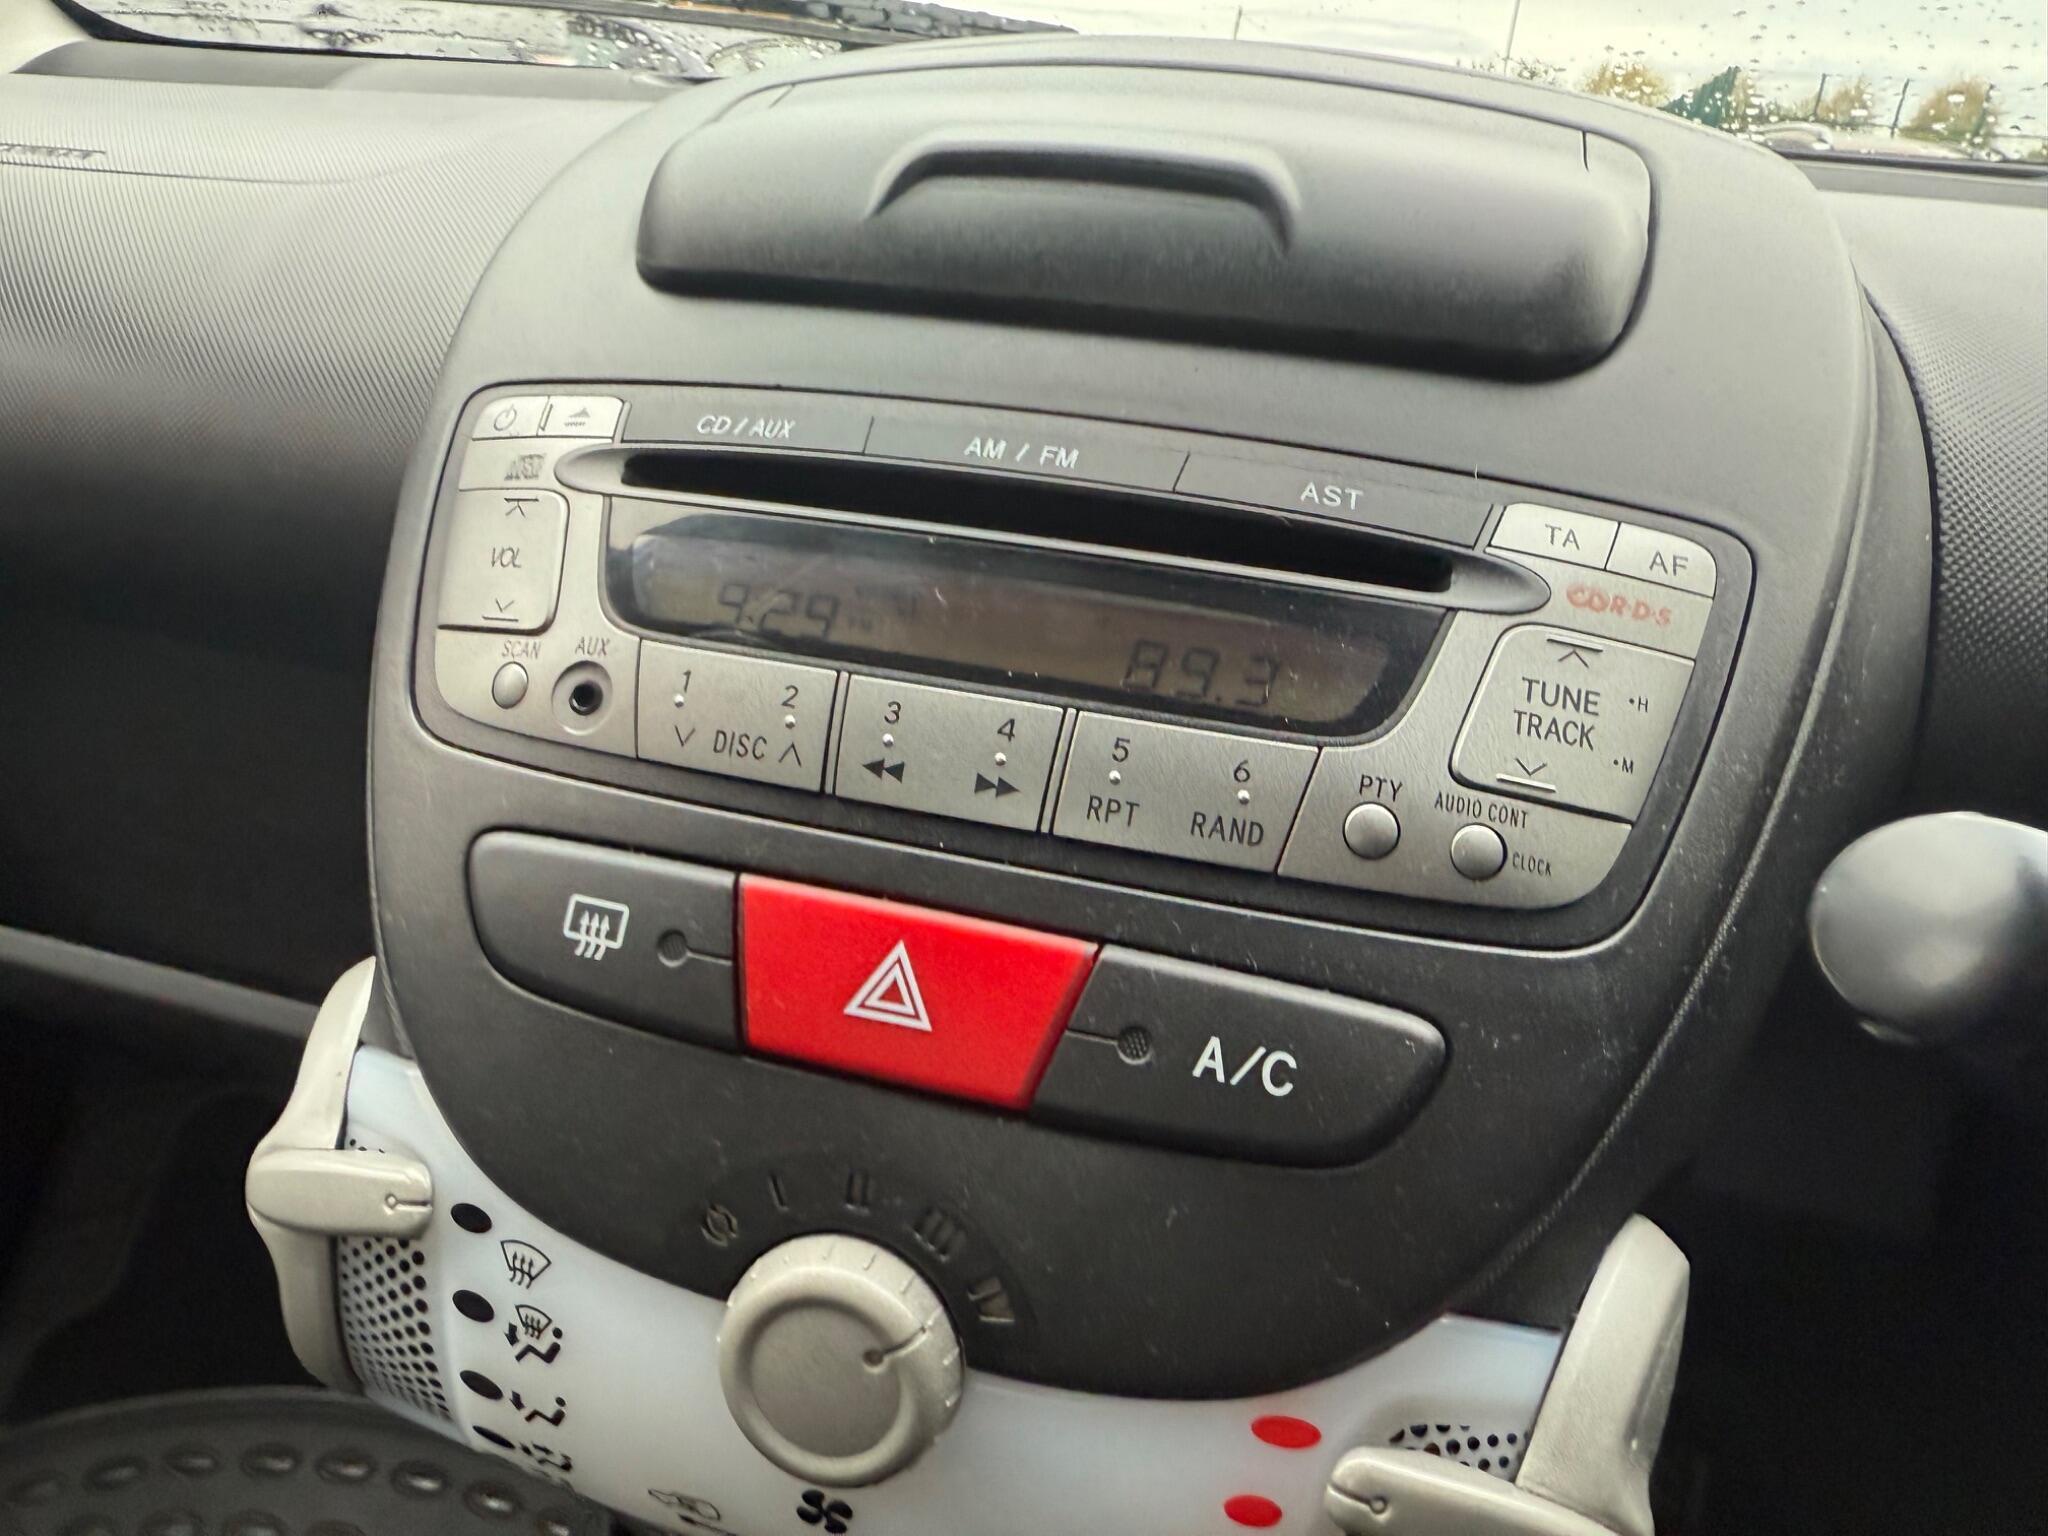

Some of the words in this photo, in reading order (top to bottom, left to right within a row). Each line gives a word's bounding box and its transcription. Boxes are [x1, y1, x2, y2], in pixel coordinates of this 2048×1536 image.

[963, 436, 1007, 460] AM
[1040, 445, 1080, 469] FM
[1300, 481, 1363, 510] AST
[1544, 523, 1580, 551] TA
[490, 546, 522, 569] VOL
[1648, 551, 1689, 577] AF
[501, 637, 542, 660] SCAN
[574, 636, 611, 657] AUX
[682, 670, 692, 693] 1
[1122, 639, 1281, 706] 89.3
[781, 685, 798, 709] 2
[1521, 676, 1601, 717] TUNE
[883, 701, 902, 725] 3
[996, 718, 1016, 743] 4
[1512, 708, 1596, 752] TRACK
[712, 730, 768, 760] DISC
[1111, 737, 1131, 763] 5
[1233, 759, 1251, 783] 6
[1358, 774, 1403, 801] PTY
[1086, 794, 1141, 828] RPT
[1433, 791, 1483, 818] AUDIO
[1487, 803, 1530, 830] CONT
[1190, 811, 1265, 847] RAND
[1512, 852, 1552, 877] CLOCK
[1192, 1035, 1298, 1097] A/C
